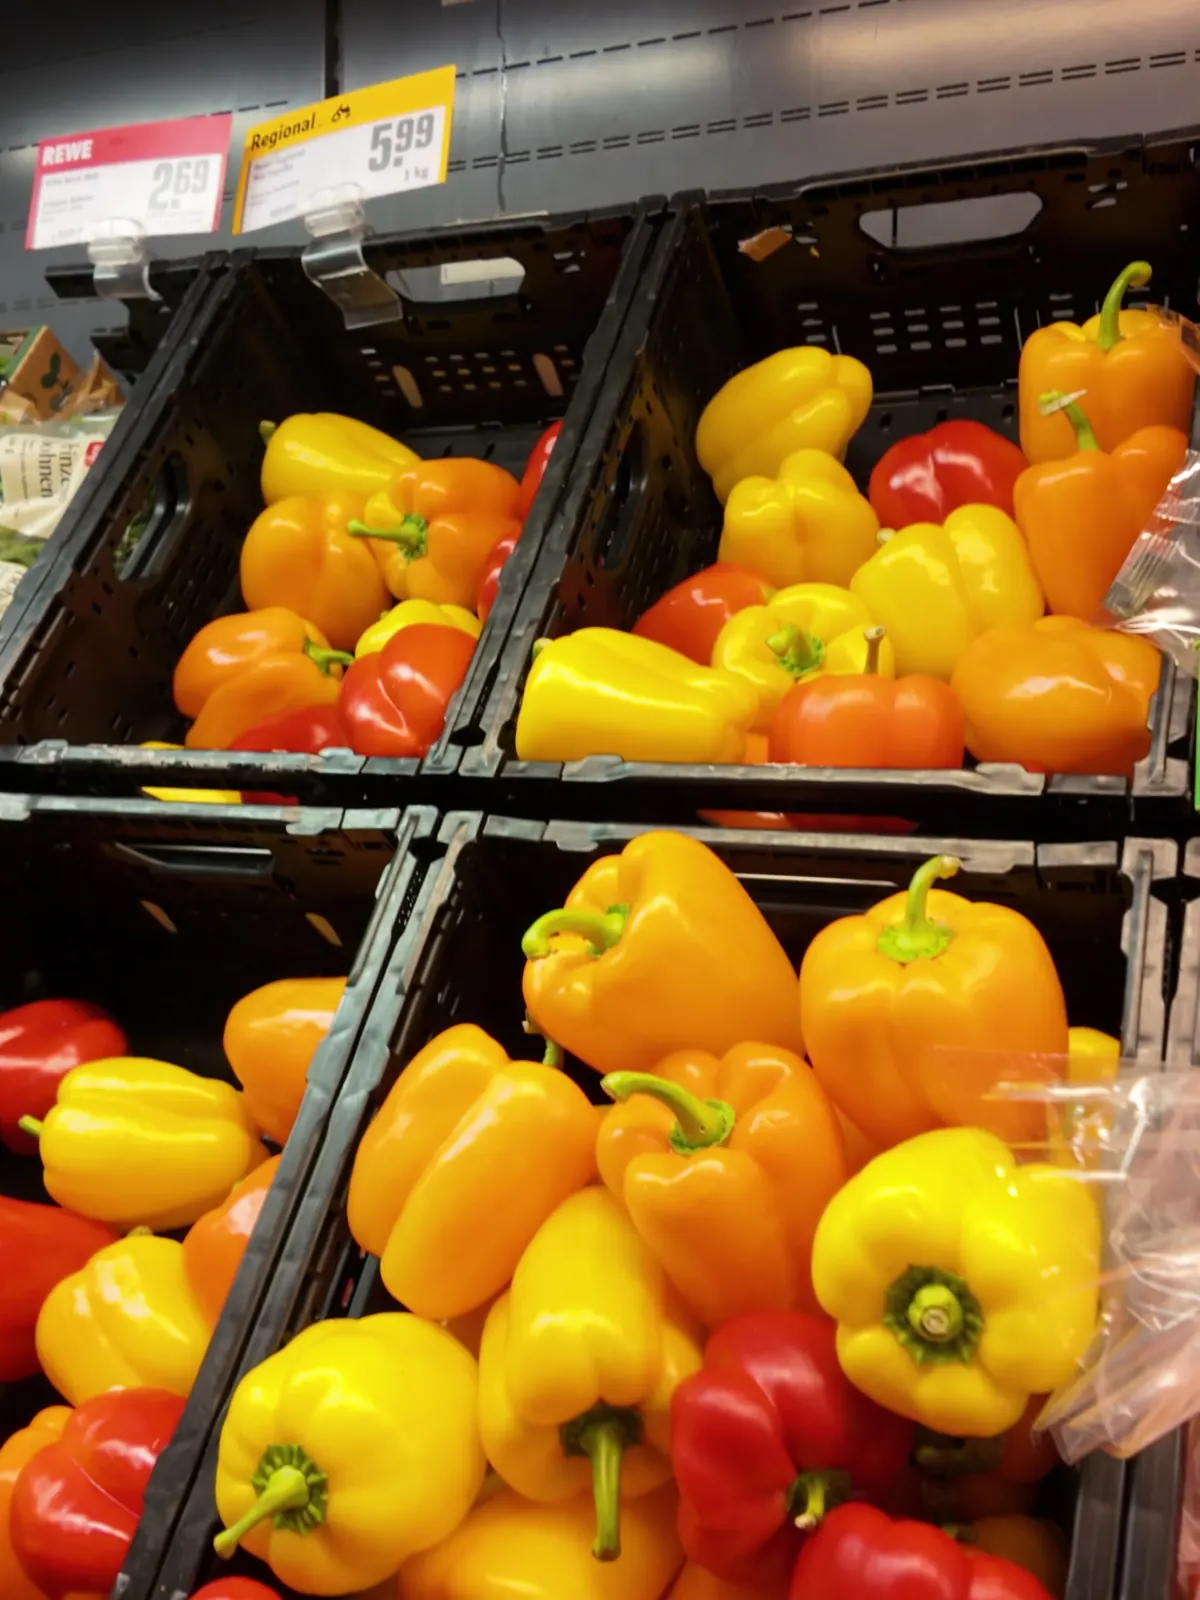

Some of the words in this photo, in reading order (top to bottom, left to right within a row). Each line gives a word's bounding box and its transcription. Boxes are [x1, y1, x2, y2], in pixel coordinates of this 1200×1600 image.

[251, 112, 316, 151] Regional
[368, 113, 435, 173] 5.99
[42, 139, 94, 166] REWE
[148, 159, 210, 210] 2.69
[414, 167, 429, 180] kg
